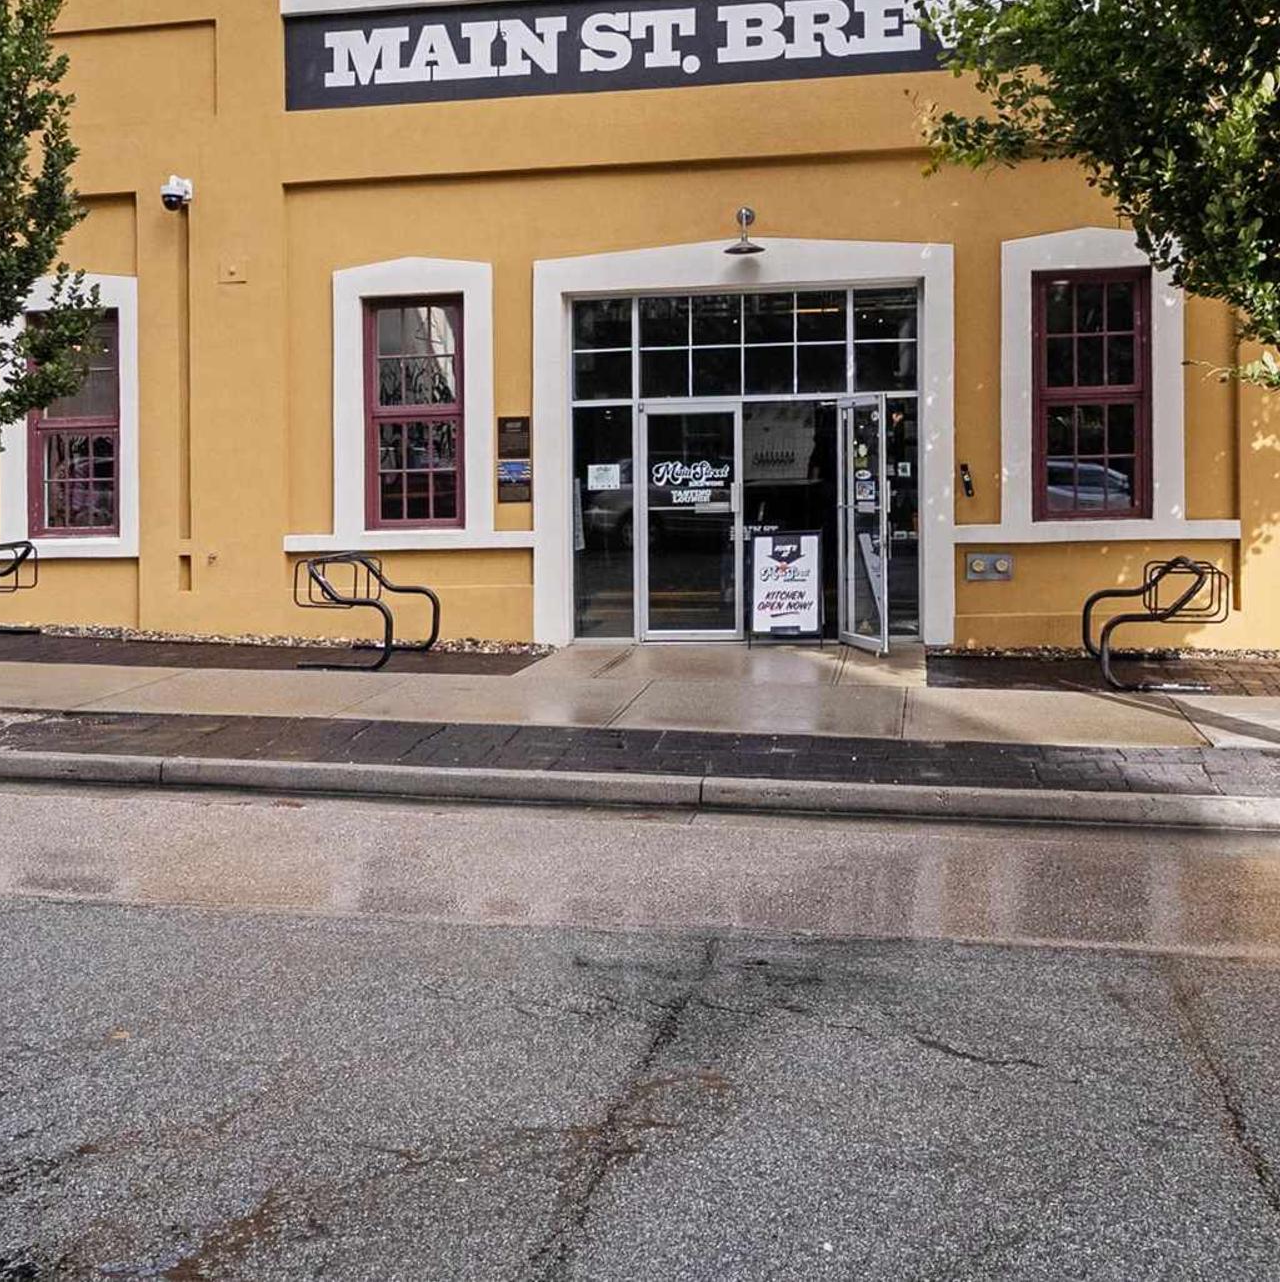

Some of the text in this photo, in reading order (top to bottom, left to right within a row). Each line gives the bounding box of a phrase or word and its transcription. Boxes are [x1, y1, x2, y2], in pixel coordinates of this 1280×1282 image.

[324, 16, 567, 88] MAIN
[579, 7, 702, 75] ST.
[652, 461, 691, 486] Main
[765, 590, 806, 600] KITCHEN
[757, 600, 814, 611] OPEN NOW!
